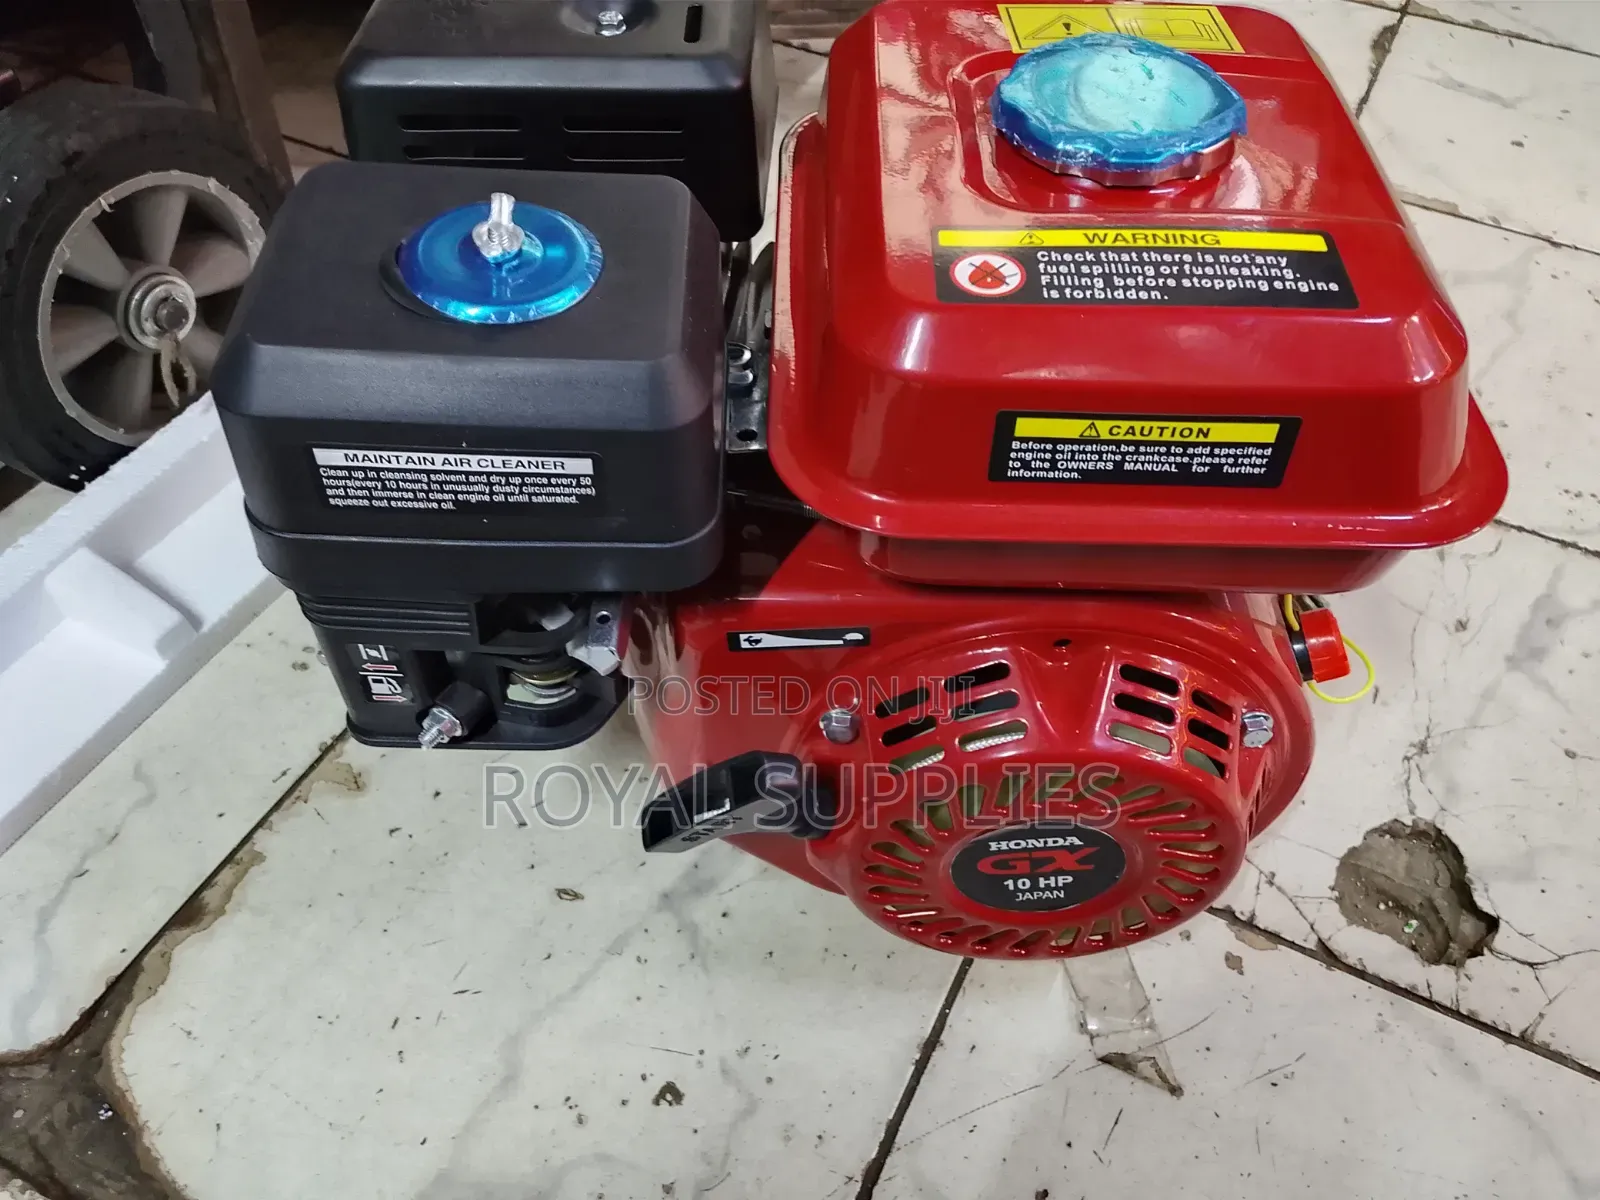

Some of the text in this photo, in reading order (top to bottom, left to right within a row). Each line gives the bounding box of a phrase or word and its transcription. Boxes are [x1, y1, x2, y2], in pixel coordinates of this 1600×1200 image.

[1083, 232, 1222, 246] WARNING
[1037, 250, 1288, 267] Check that there is not any
[1038, 262, 1076, 274] fuel
[1080, 262, 1155, 276] spilling
[1159, 264, 1180, 275] or
[1040, 275, 1340, 292] Filling before stopping engine
[1042, 287, 1169, 300] is forbidden.
[1108, 425, 1211, 439] CAUTION
[1011, 441, 1053, 451] Before
[1139, 445, 1167, 454] sure
[1171, 445, 1184, 454] to
[1187, 446, 1210, 455] add
[1213, 447, 1272, 457] specified
[344, 453, 566, 470] MAINTAIN AIR CLEANER
[1010, 450, 1052, 460] engine
[1055, 451, 1072, 461] oil
[1074, 452, 1099, 461] into
[1102, 452, 1122, 461] the
[1238, 456, 1268, 465] refer
[1007, 469, 1082, 479] information.
[1008, 460, 1267, 474] to the OWNERS MANUAL for further
[320, 467, 592, 487] Clean up in cleansing solvent and dry up once every 50
[326, 487, 579, 504] and then immerse in clean engine oil until saturated.
[385, 480, 397, 489] 10
[399, 480, 428, 490] hours
[430, 481, 441, 490] in
[442, 482, 490, 493] unusually
[492, 484, 520, 495] dusty
[522, 485, 596, 497] circumstances)
[328, 497, 456, 510] squeeze out excessive oil.
[988, 836, 1084, 851] HONDA
[977, 847, 1101, 875] GX
[1003, 875, 1074, 891] 10 HP
[1015, 889, 1065, 902] JAPAN
